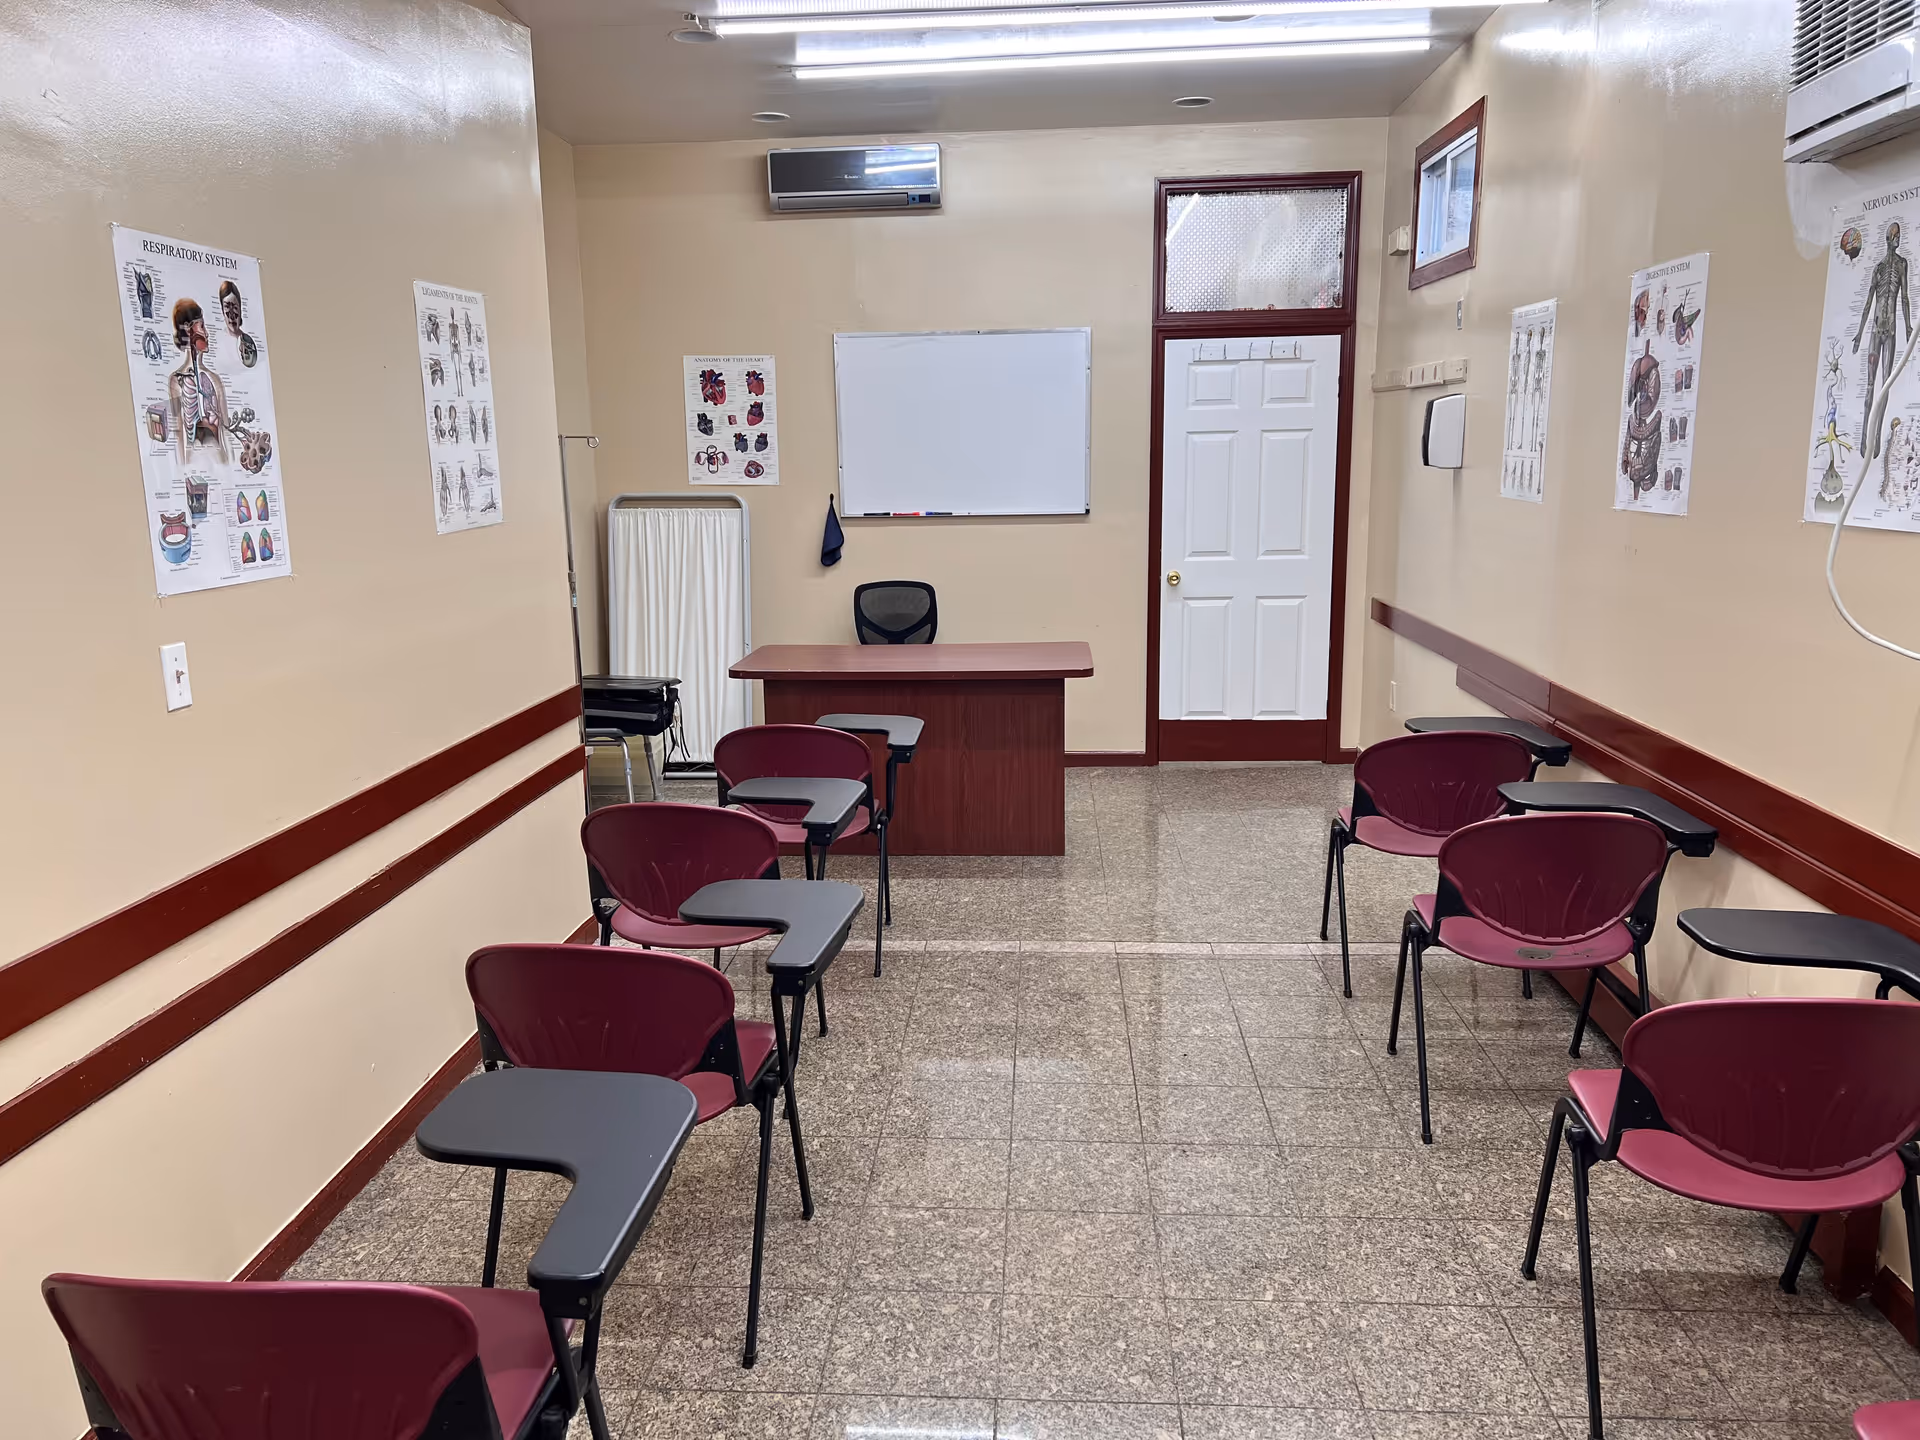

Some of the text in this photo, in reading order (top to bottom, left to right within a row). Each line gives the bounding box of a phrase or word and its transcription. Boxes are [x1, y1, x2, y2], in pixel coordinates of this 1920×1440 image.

[1862, 192, 1899, 212] NERVOUS
[142, 239, 238, 270] RESPIRATORY SYSTEM
[1645, 260, 1691, 281] DIGESTIVE SYSTEM
